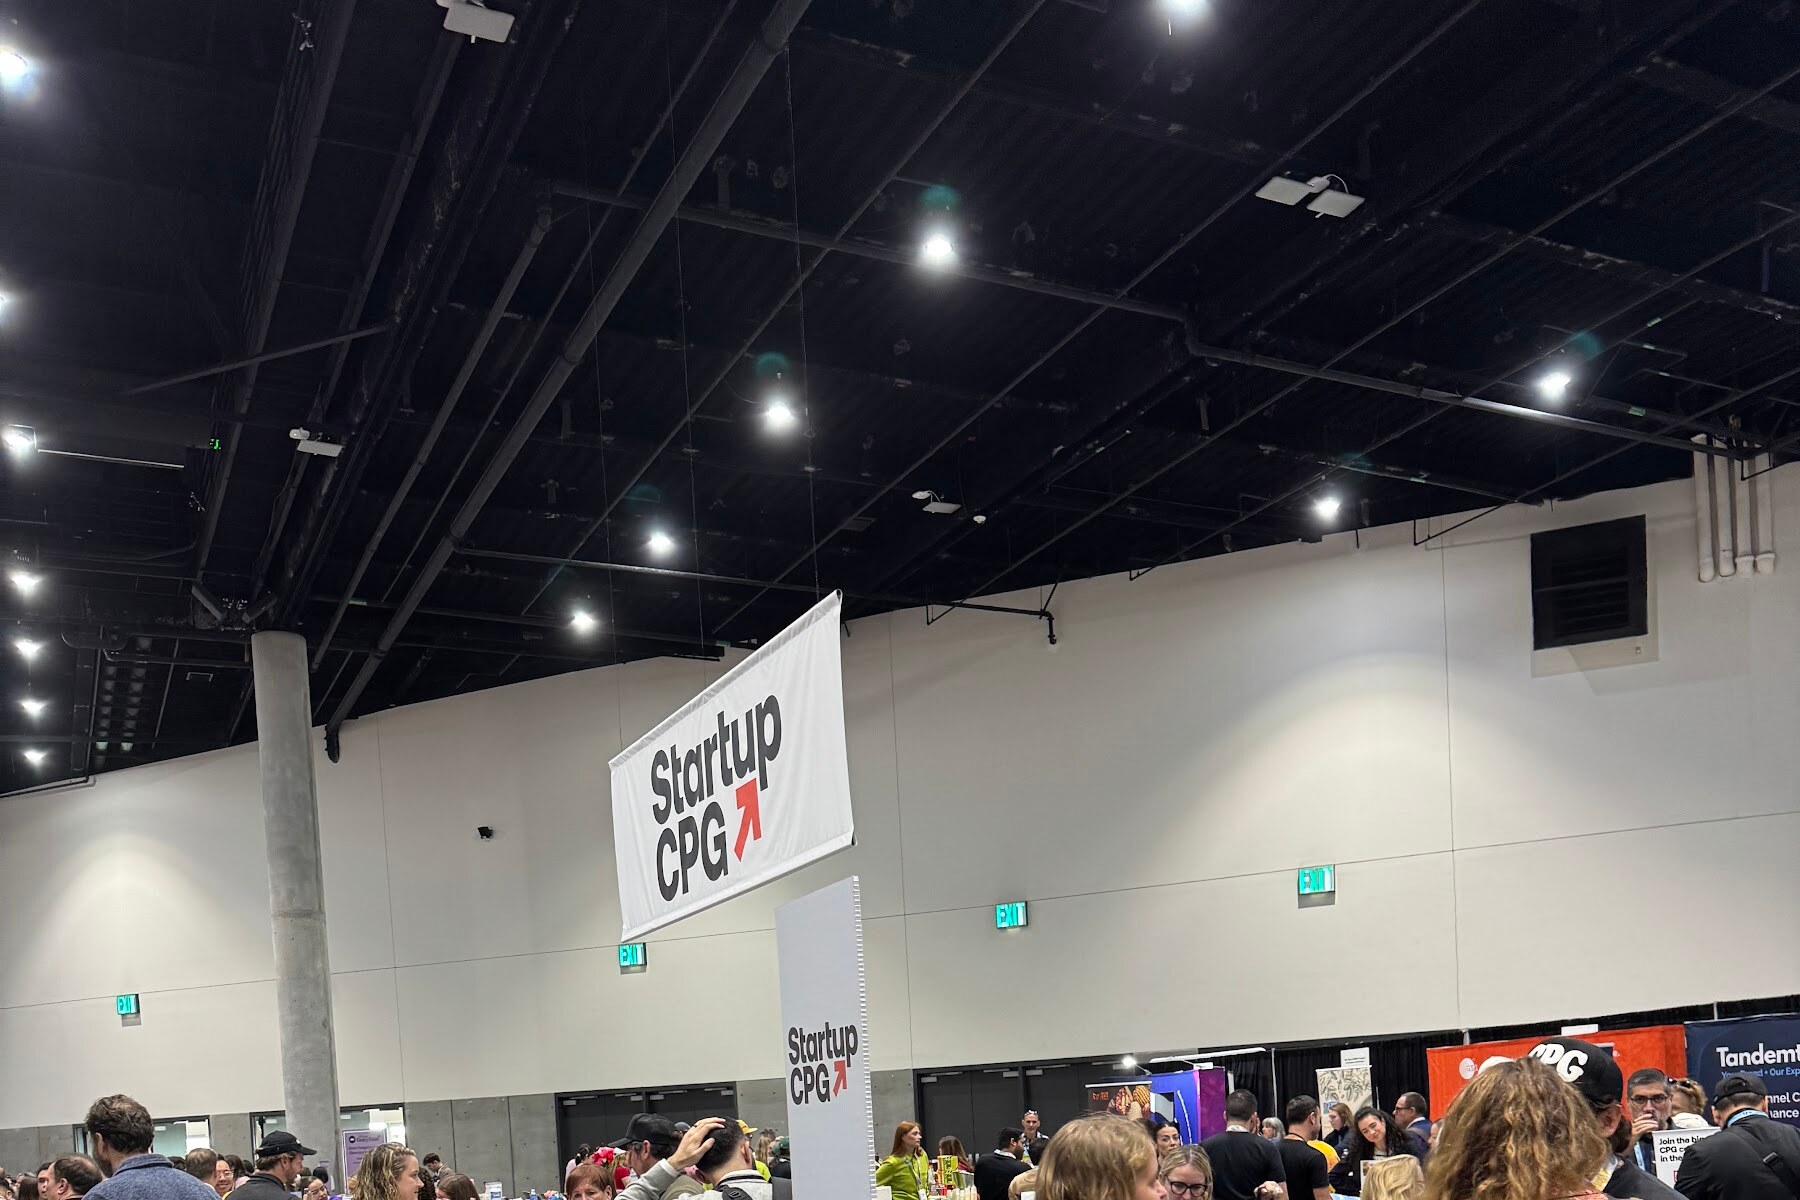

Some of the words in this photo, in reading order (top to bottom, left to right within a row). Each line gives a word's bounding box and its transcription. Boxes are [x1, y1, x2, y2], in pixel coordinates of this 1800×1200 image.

[650, 695, 782, 825] Startup
[655, 801, 729, 902] CPG
[1299, 866, 1334, 894] EXIT
[997, 902, 1025, 928] EXIT
[788, 1021, 858, 1068] Startup
[790, 1063, 831, 1105] CPG
[1769, 1068, 1784, 1077] Our
[1767, 1091, 1791, 1104] nnel
[1659, 1137, 1675, 1145] Join
[1660, 1146, 1677, 1154] CPG
